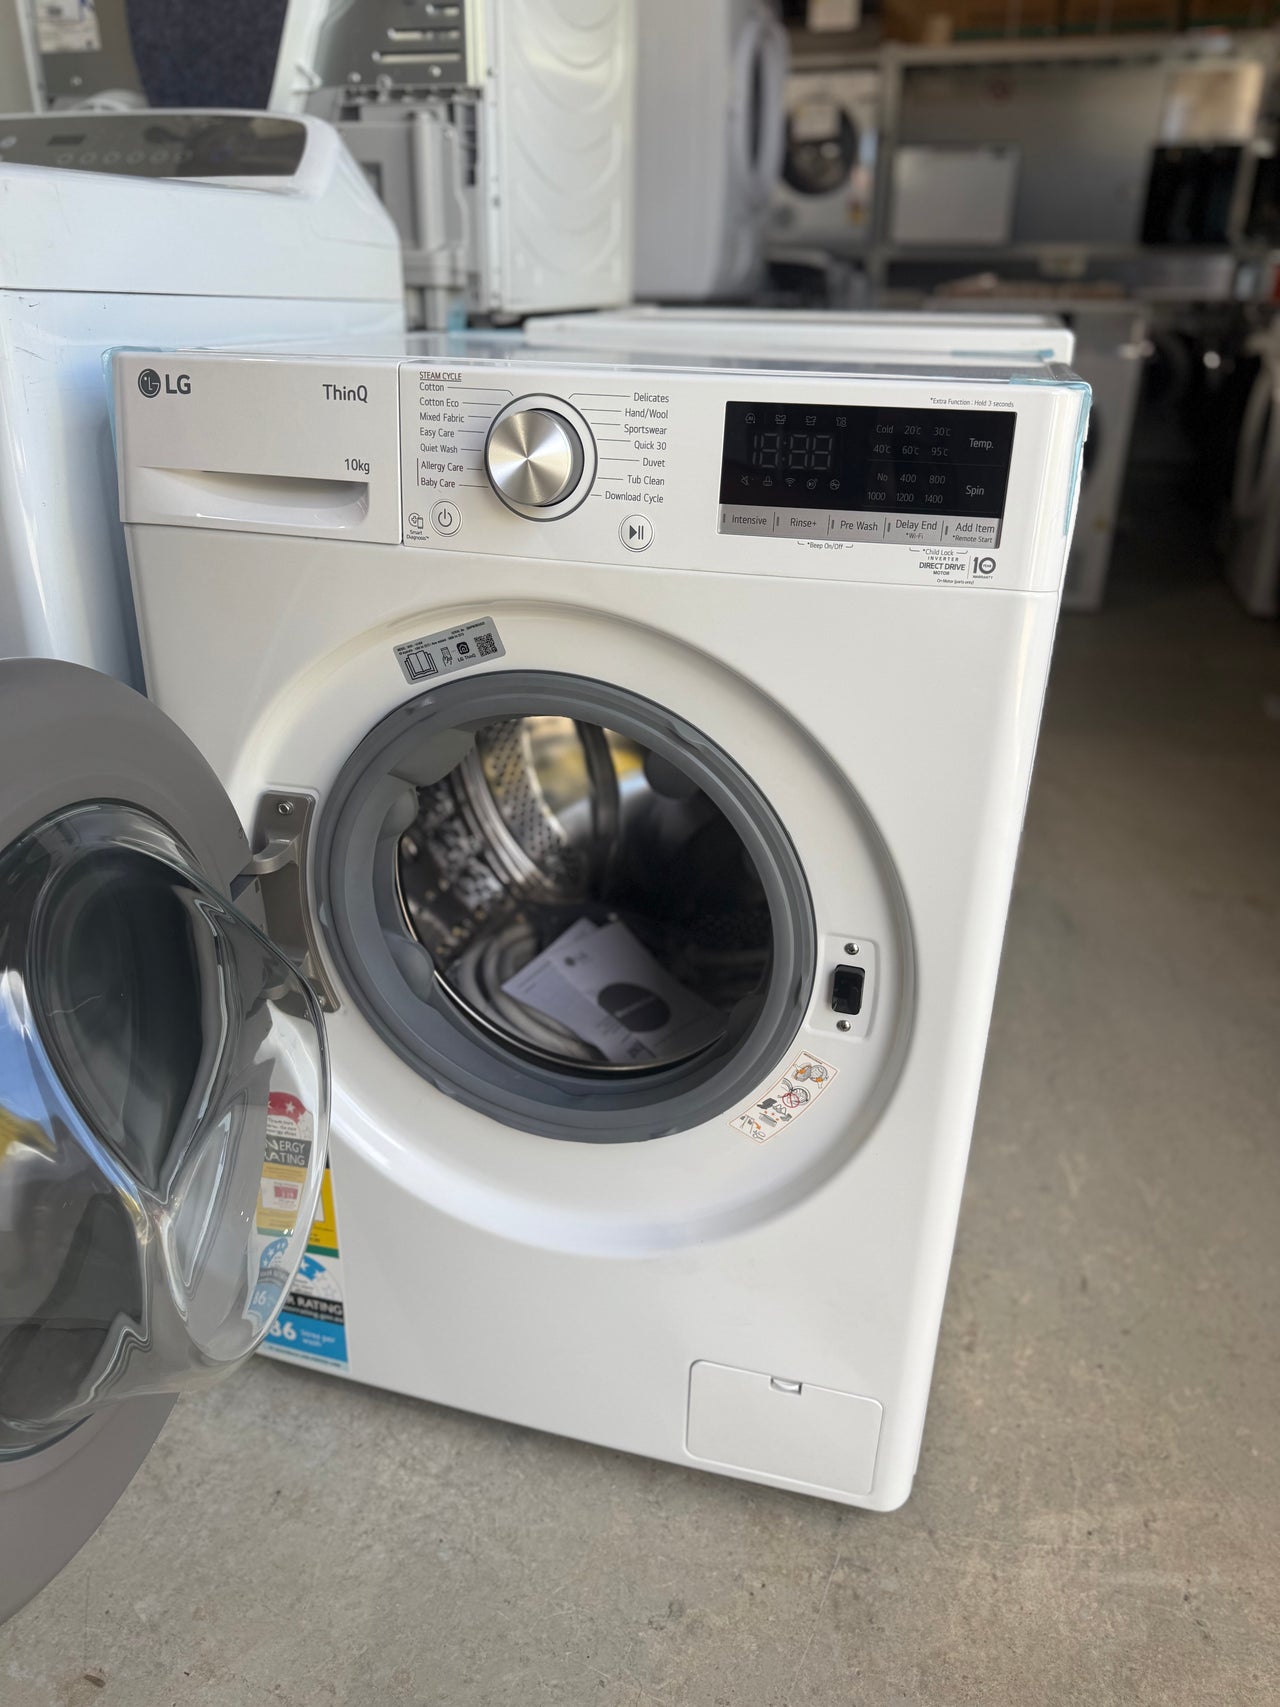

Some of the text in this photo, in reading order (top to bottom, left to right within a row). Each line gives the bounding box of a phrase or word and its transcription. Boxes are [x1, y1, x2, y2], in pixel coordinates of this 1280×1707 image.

[420, 372, 462, 380] STEAM CYCLE
[166, 374, 192, 394] LG
[420, 382, 444, 391] Cotton
[322, 384, 368, 403] ThinQ
[634, 392, 669, 403] Delicates
[420, 397, 459, 407] Cotton Eco
[420, 412, 464, 423] Mixed Fabric
[625, 408, 668, 419] Hand/Wool
[420, 427, 454, 438] Easy Care
[624, 424, 667, 435] Sportswear
[876, 425, 894, 434] Cold
[420, 443, 458, 453] Quiet Wash
[634, 441, 666, 450] Quick 30
[969, 438, 994, 450] Temp.
[344, 459, 370, 474] 10kg
[421, 461, 464, 472] Allergy Care
[643, 458, 665, 467] Duvet
[421, 477, 455, 488] Baby Care
[627, 475, 664, 485] Tub Clean
[877, 473, 946, 484] No 400 800
[966, 485, 984, 496] Spin
[605, 491, 664, 504] Download Cycle
[868, 492, 943, 504] 1000 1200 1400
[732, 514, 767, 525] Intensive
[790, 517, 816, 528] Rinse+
[896, 519, 938, 531] Delay End
[840, 520, 878, 531] Pre Wash
[955, 522, 995, 534] Add Item
